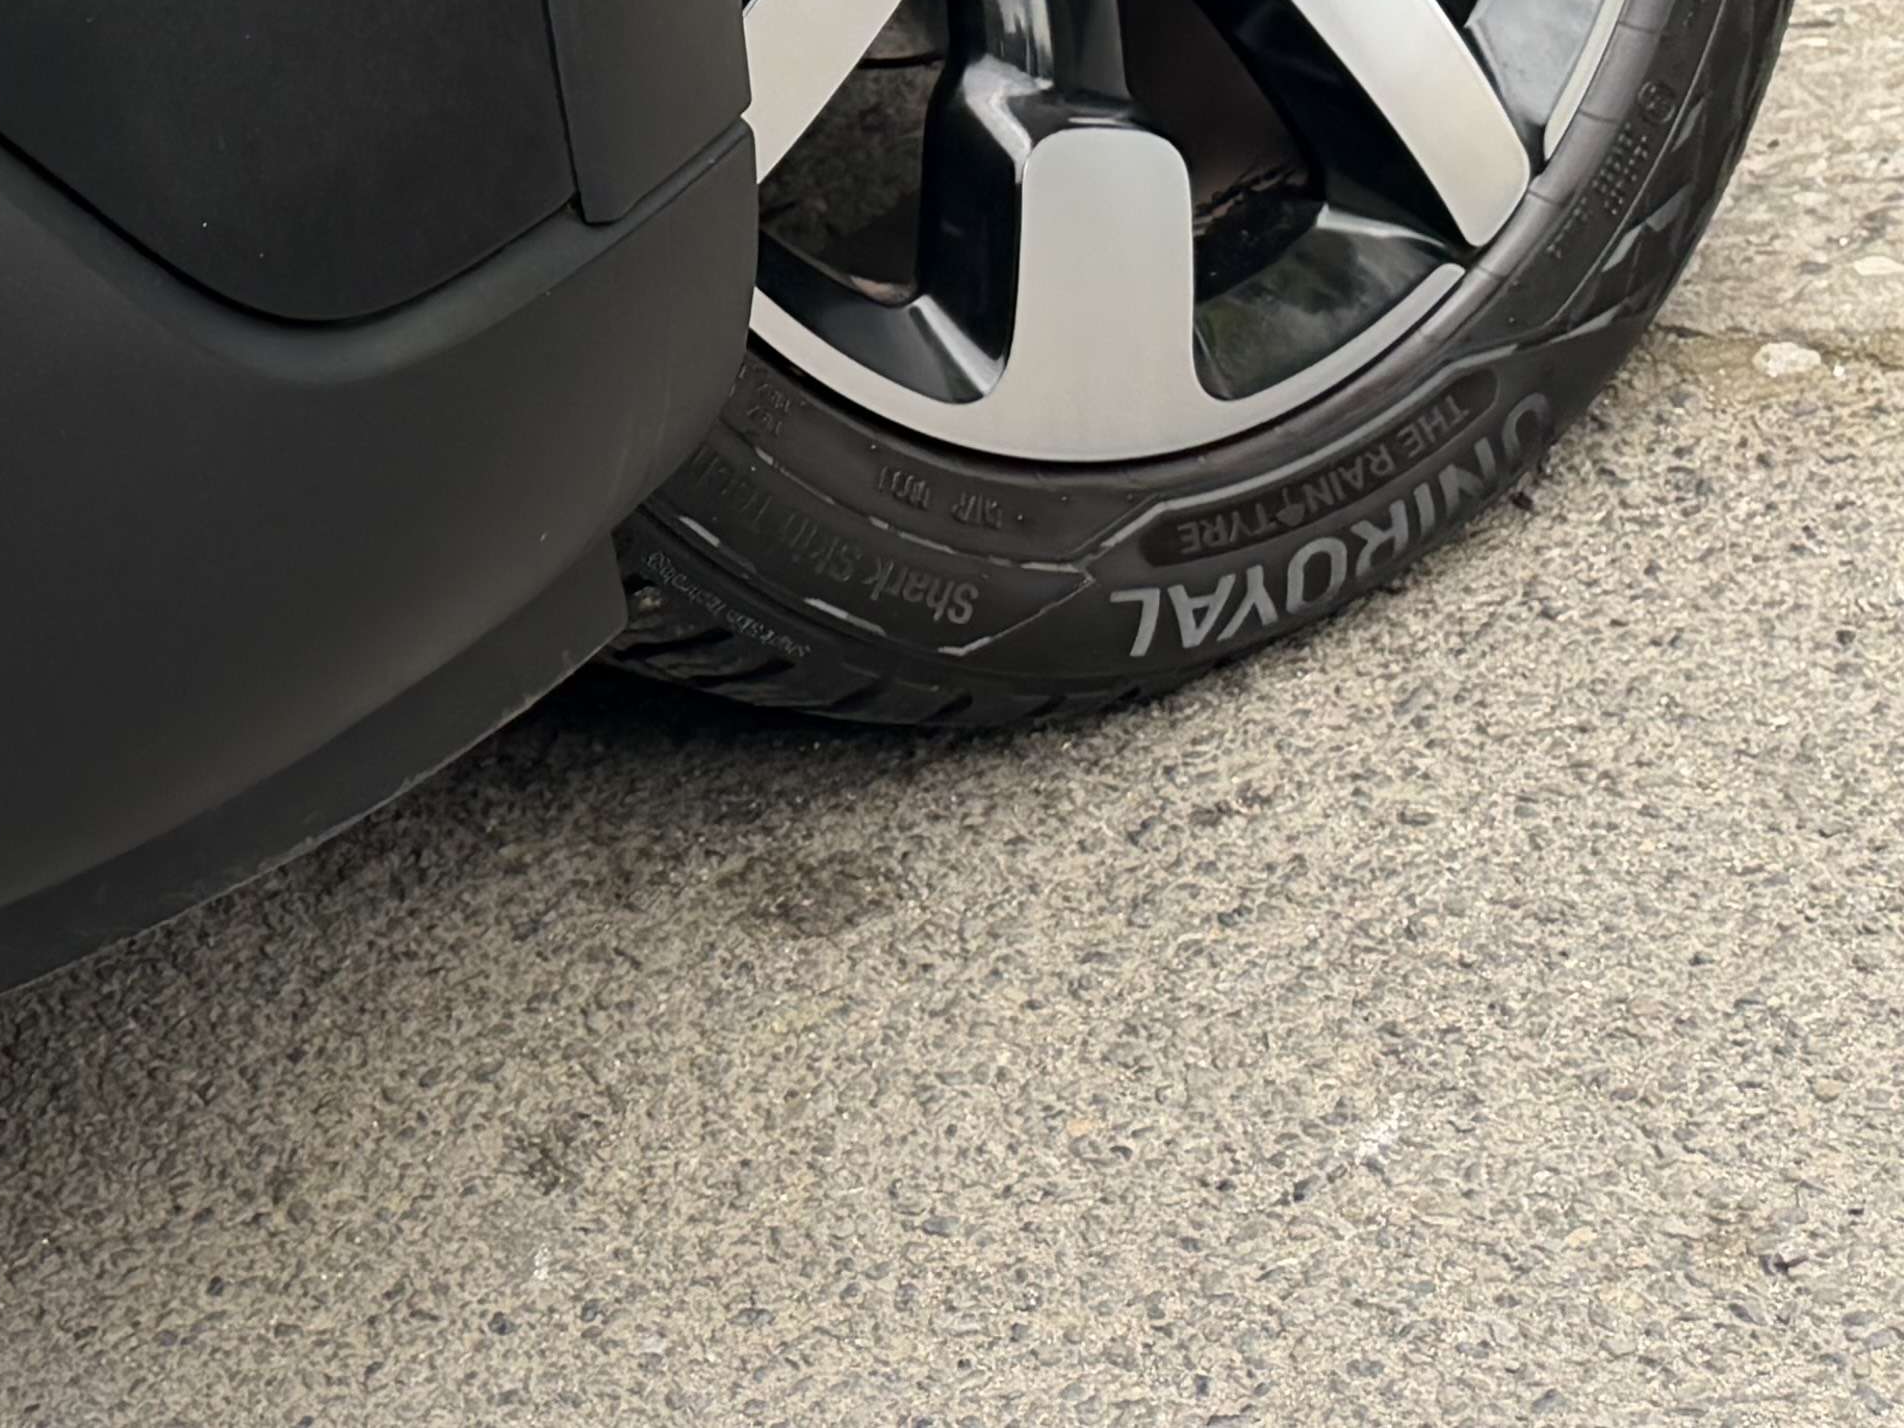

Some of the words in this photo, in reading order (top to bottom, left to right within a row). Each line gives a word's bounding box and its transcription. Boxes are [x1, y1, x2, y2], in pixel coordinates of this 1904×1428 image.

[1394, 392, 1472, 457] THE
[1302, 440, 1396, 516] RAIN
[1108, 390, 1551, 659] UNIROYAL
[1176, 500, 1279, 555] TYRE
[861, 555, 980, 625] Shark
